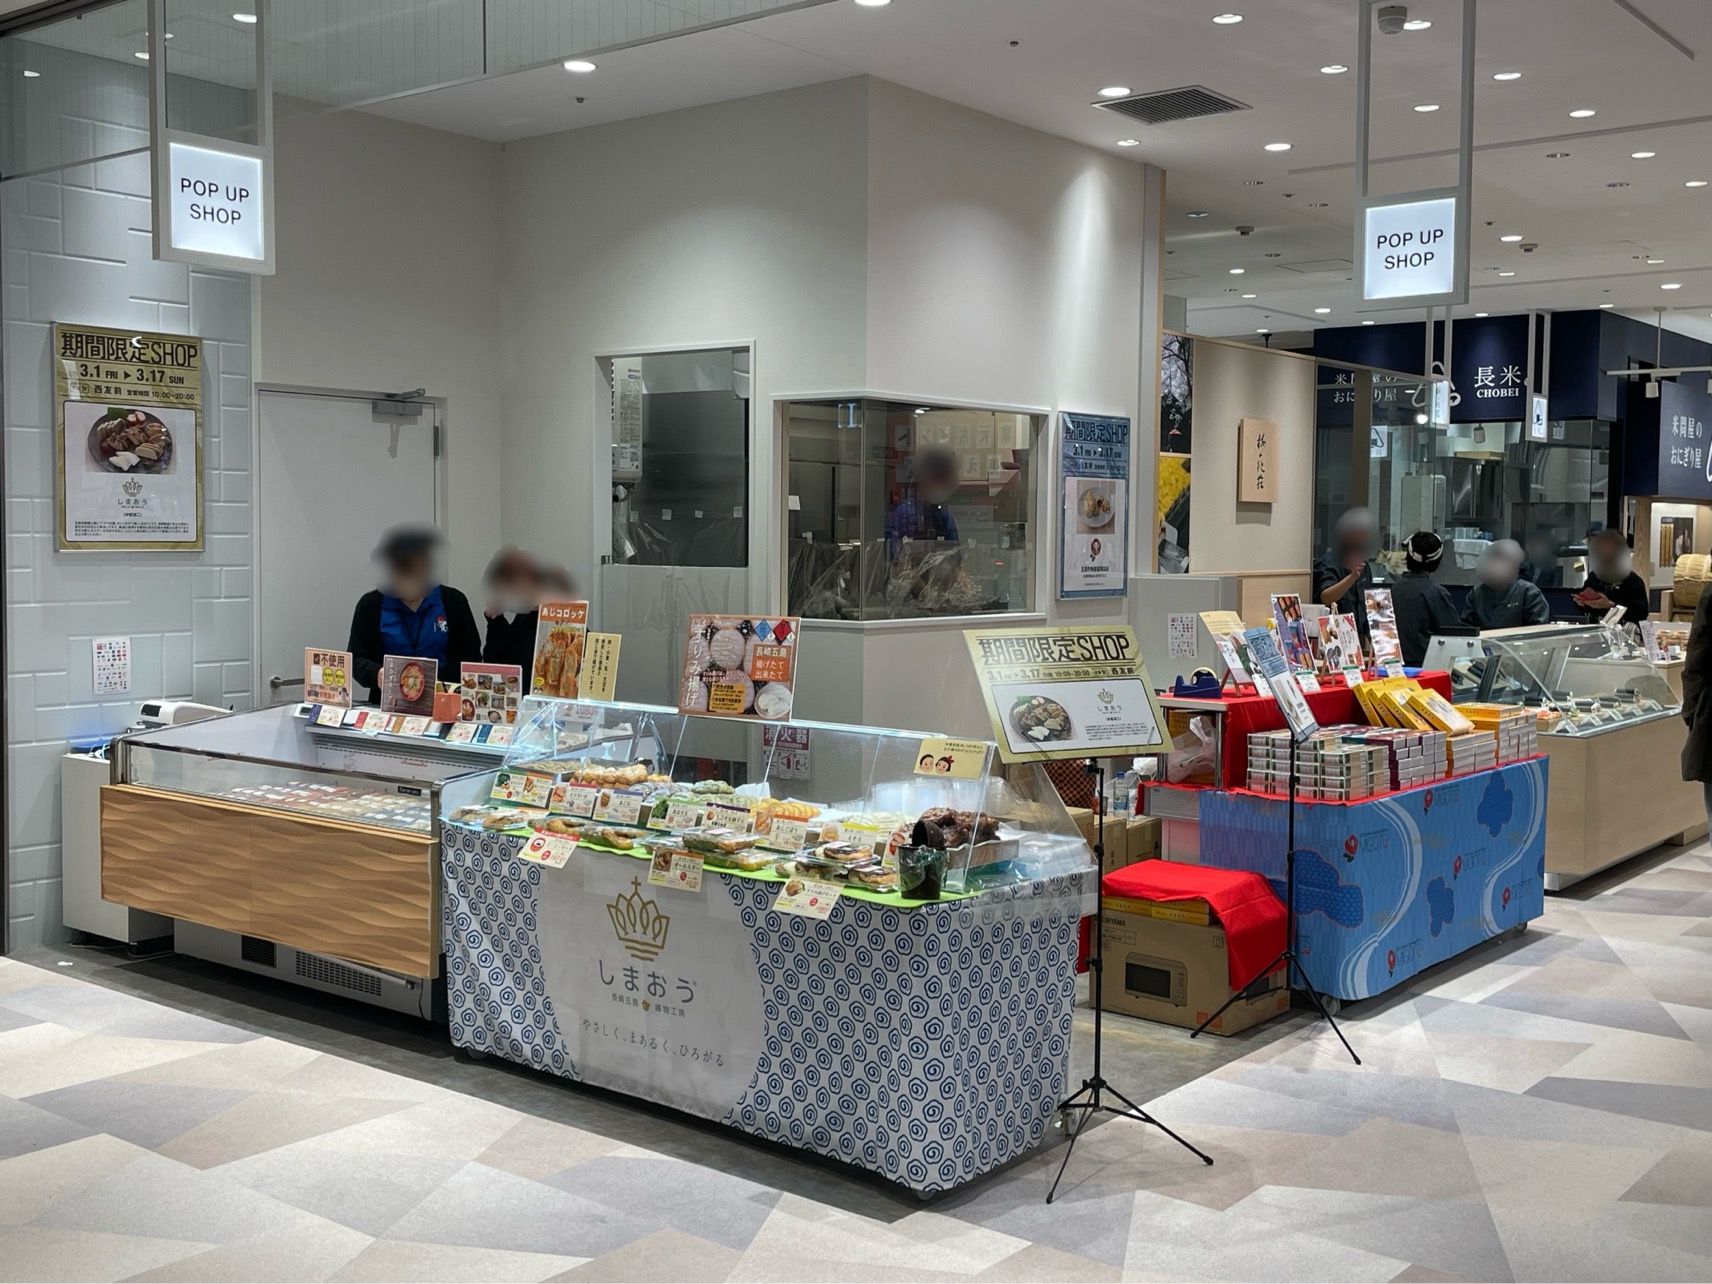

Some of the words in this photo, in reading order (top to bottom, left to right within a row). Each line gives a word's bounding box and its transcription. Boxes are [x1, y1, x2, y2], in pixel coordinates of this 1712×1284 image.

[180, 177, 219, 199] POP
[225, 186, 250, 203] UP
[189, 203, 242, 225] SHOP
[1377, 232, 1413, 250] POP
[1420, 228, 1444, 245] UP
[1384, 251, 1435, 270] SHOP
[61, 332, 198, 367] 期間限定SHOP
[80, 363, 101, 379] 3.1
[105, 370, 119, 380] FRI
[136, 368, 165, 383] 3.17
[168, 375, 185, 385] SUN
[1474, 364, 1522, 389] 長米
[94, 384, 122, 396] 西友前
[1333, 387, 1398, 404] おにり屋
[1476, 387, 1520, 399] CHOBEI
[1064, 420, 1128, 444] 期間限定SHOP
[1670, 445, 1702, 469] おにぎり屋
[117, 498, 148, 506] しまおう
[541, 607, 585, 619] あじコロッケ
[321, 653, 345, 668] 不使用
[978, 634, 1131, 665] 期間限定SHOP
[685, 628, 707, 709] すりみ揚げ
[754, 670, 784, 681] 出来たて
[755, 659, 785, 670] 揚げたて
[1021, 668, 1041, 679] 3.17
[599, 960, 694, 1004] しまおう
[582, 1018, 724, 1067] やさしく、まあるく、ひろがる
